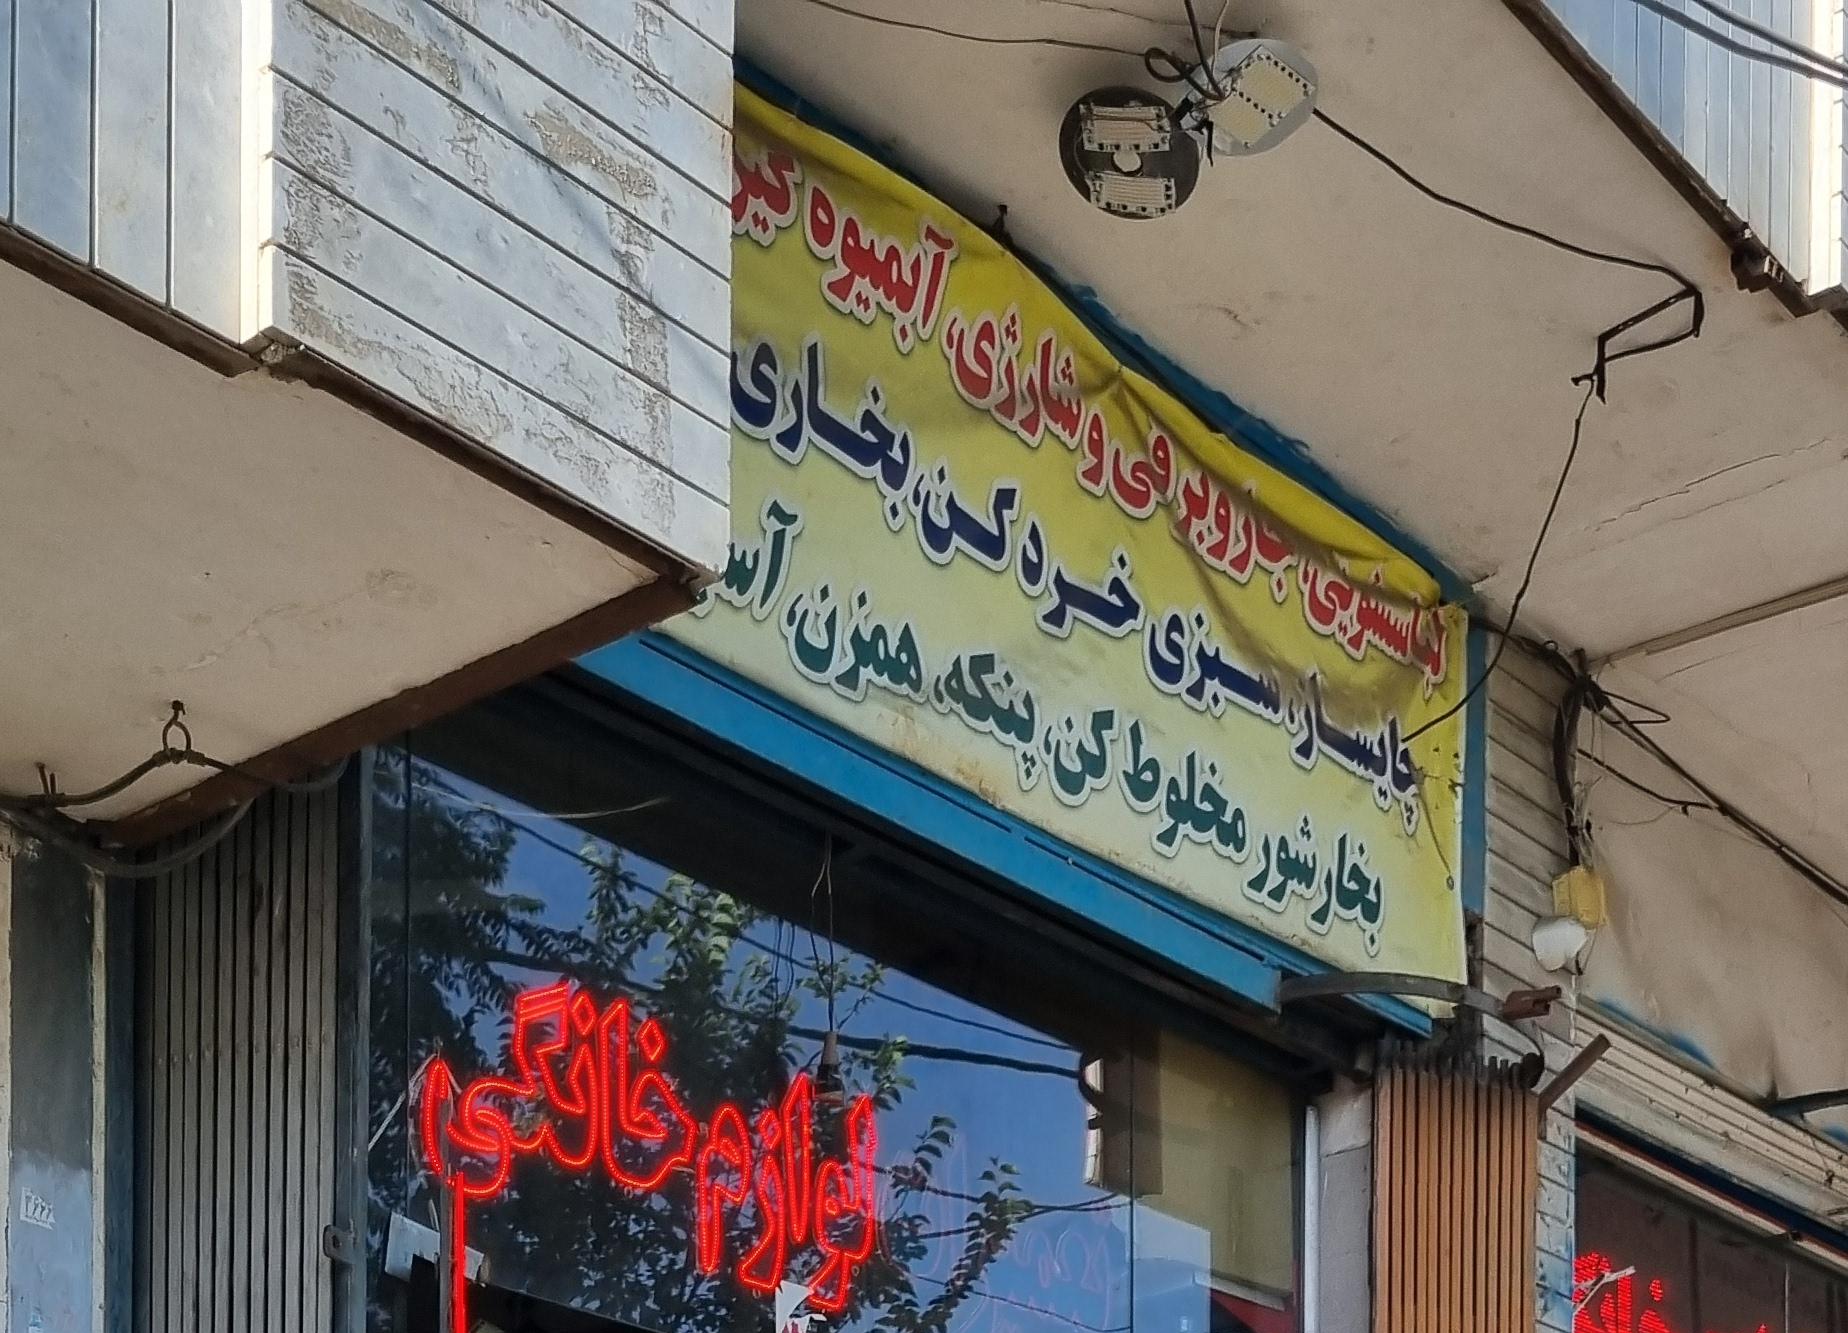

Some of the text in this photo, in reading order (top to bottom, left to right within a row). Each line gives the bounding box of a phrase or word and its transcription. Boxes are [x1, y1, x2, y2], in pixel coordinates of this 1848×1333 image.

[810, 185, 955, 344] آبمیوه
[787, 583, 923, 693] همزن،
[1148, 612, 1281, 714] سبزی
[934, 652, 1036, 780] پنکه،
[1122, 719, 1247, 854] مخلوط
[418, 980, 698, 1199] خانگی
[696, 1072, 879, 1312] لوازم
